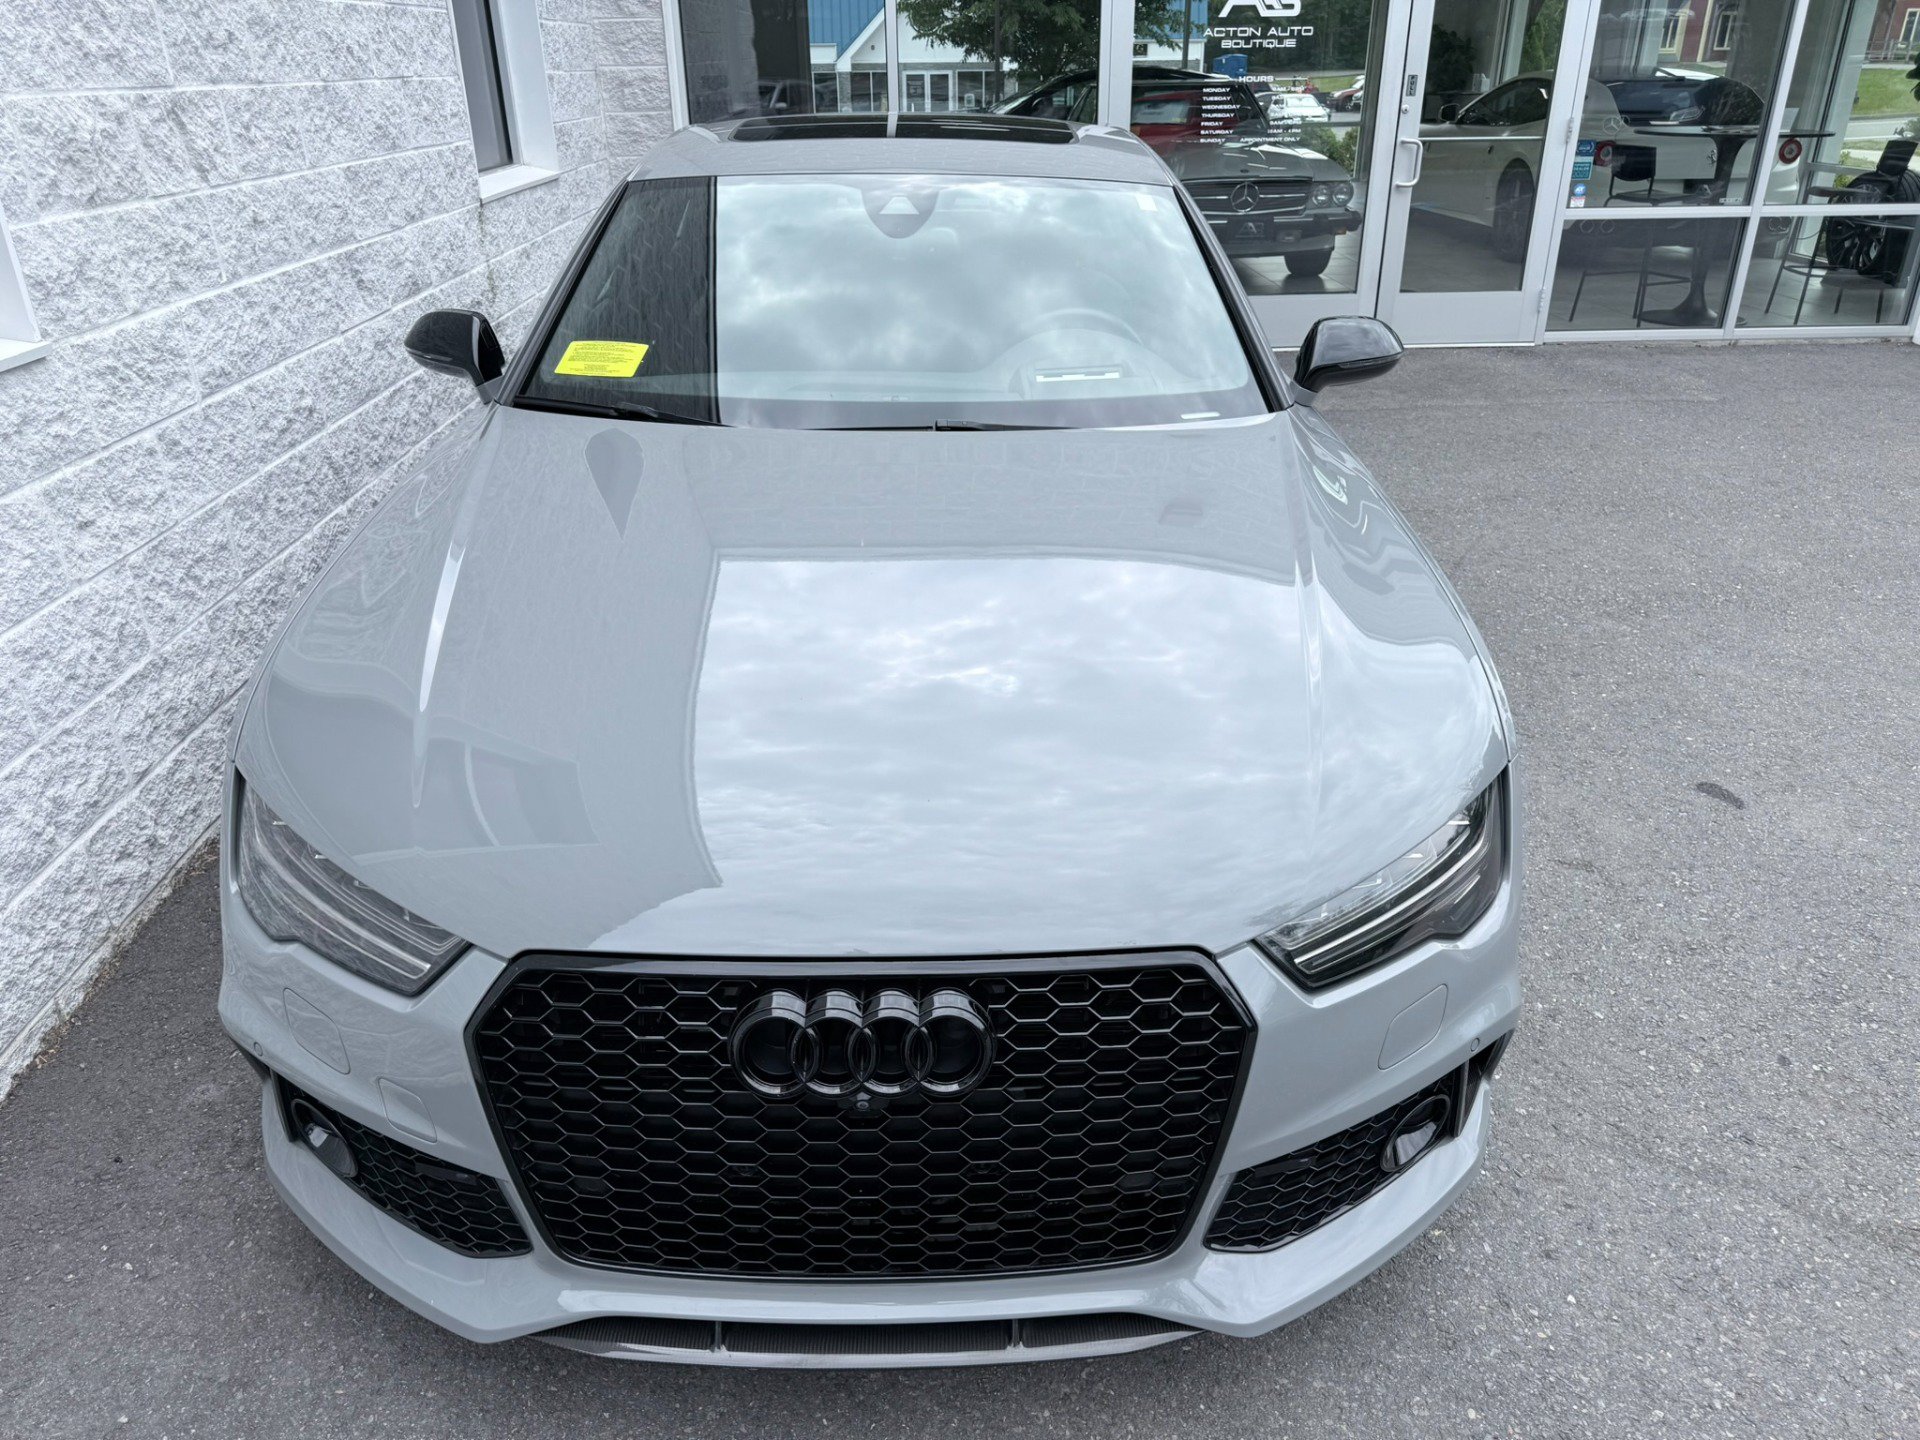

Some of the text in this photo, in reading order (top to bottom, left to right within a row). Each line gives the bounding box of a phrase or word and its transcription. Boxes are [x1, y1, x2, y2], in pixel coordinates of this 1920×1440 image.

[1203, 26, 1314, 37] ACTON AUTO
[1221, 39, 1297, 48] BOUTIQUE
[1238, 75, 1274, 83] HOURS
